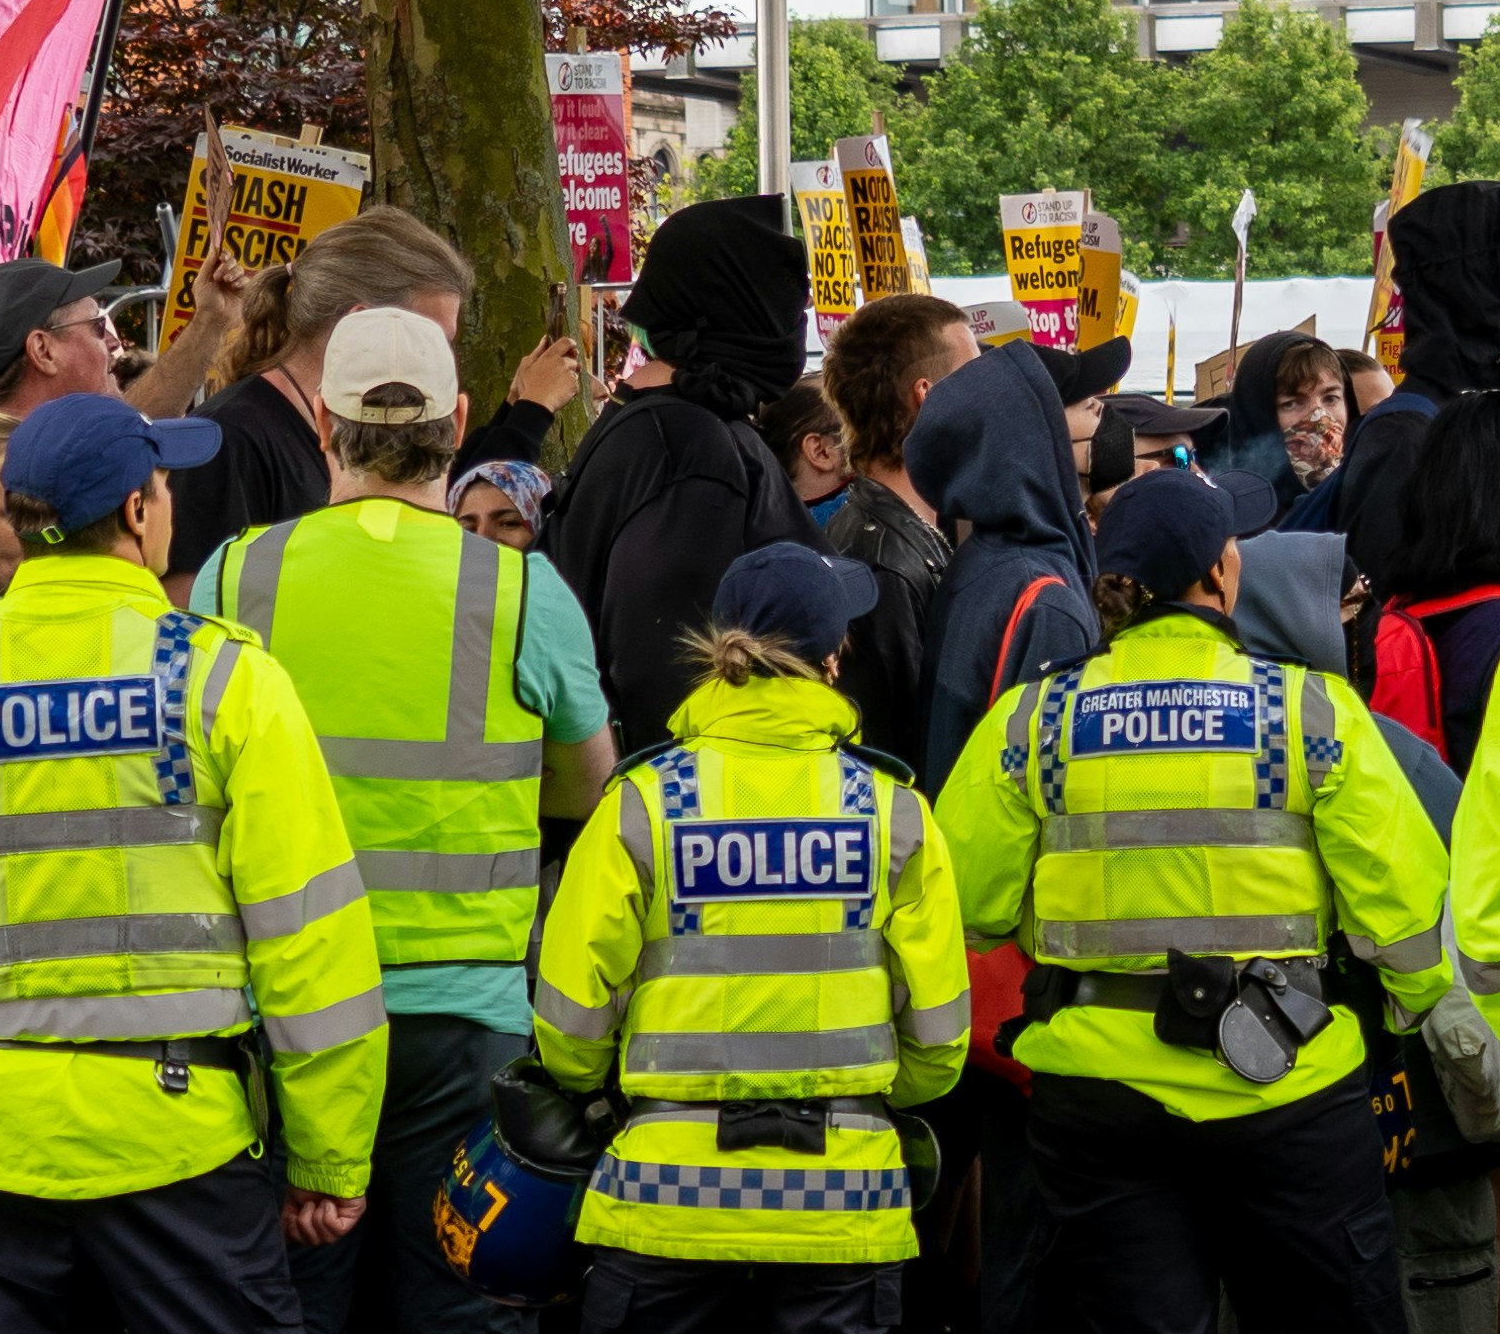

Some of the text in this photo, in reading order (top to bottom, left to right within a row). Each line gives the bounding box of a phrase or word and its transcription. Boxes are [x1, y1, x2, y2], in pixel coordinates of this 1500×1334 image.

[574, 77, 607, 90] TO RACISM
[553, 103, 564, 118] ay
[566, 100, 575, 117] it
[567, 124, 577, 141] it
[578, 124, 608, 141] clear:
[224, 144, 287, 172] Socialist
[287, 156, 340, 181] Worker
[558, 145, 623, 183] efugees
[563, 180, 622, 211] elcome
[1038, 199, 1073, 213] STAND UP
[804, 197, 834, 222] NO
[854, 205, 899, 234] RAISM
[1038, 210, 1078, 223] TO RACISM
[184, 217, 308, 270] FSCIS
[569, 222, 588, 246] re
[810, 224, 853, 251] RACIS
[814, 252, 836, 278] NO
[970, 321, 996, 335] CISM
[972, 310, 987, 323] UP
[1081, 688, 1249, 714] GREATER MANCHESTER
[1102, 709, 1225, 745] POLICE
[681, 830, 863, 888] POLICE
[478, 1180, 509, 1233] L
